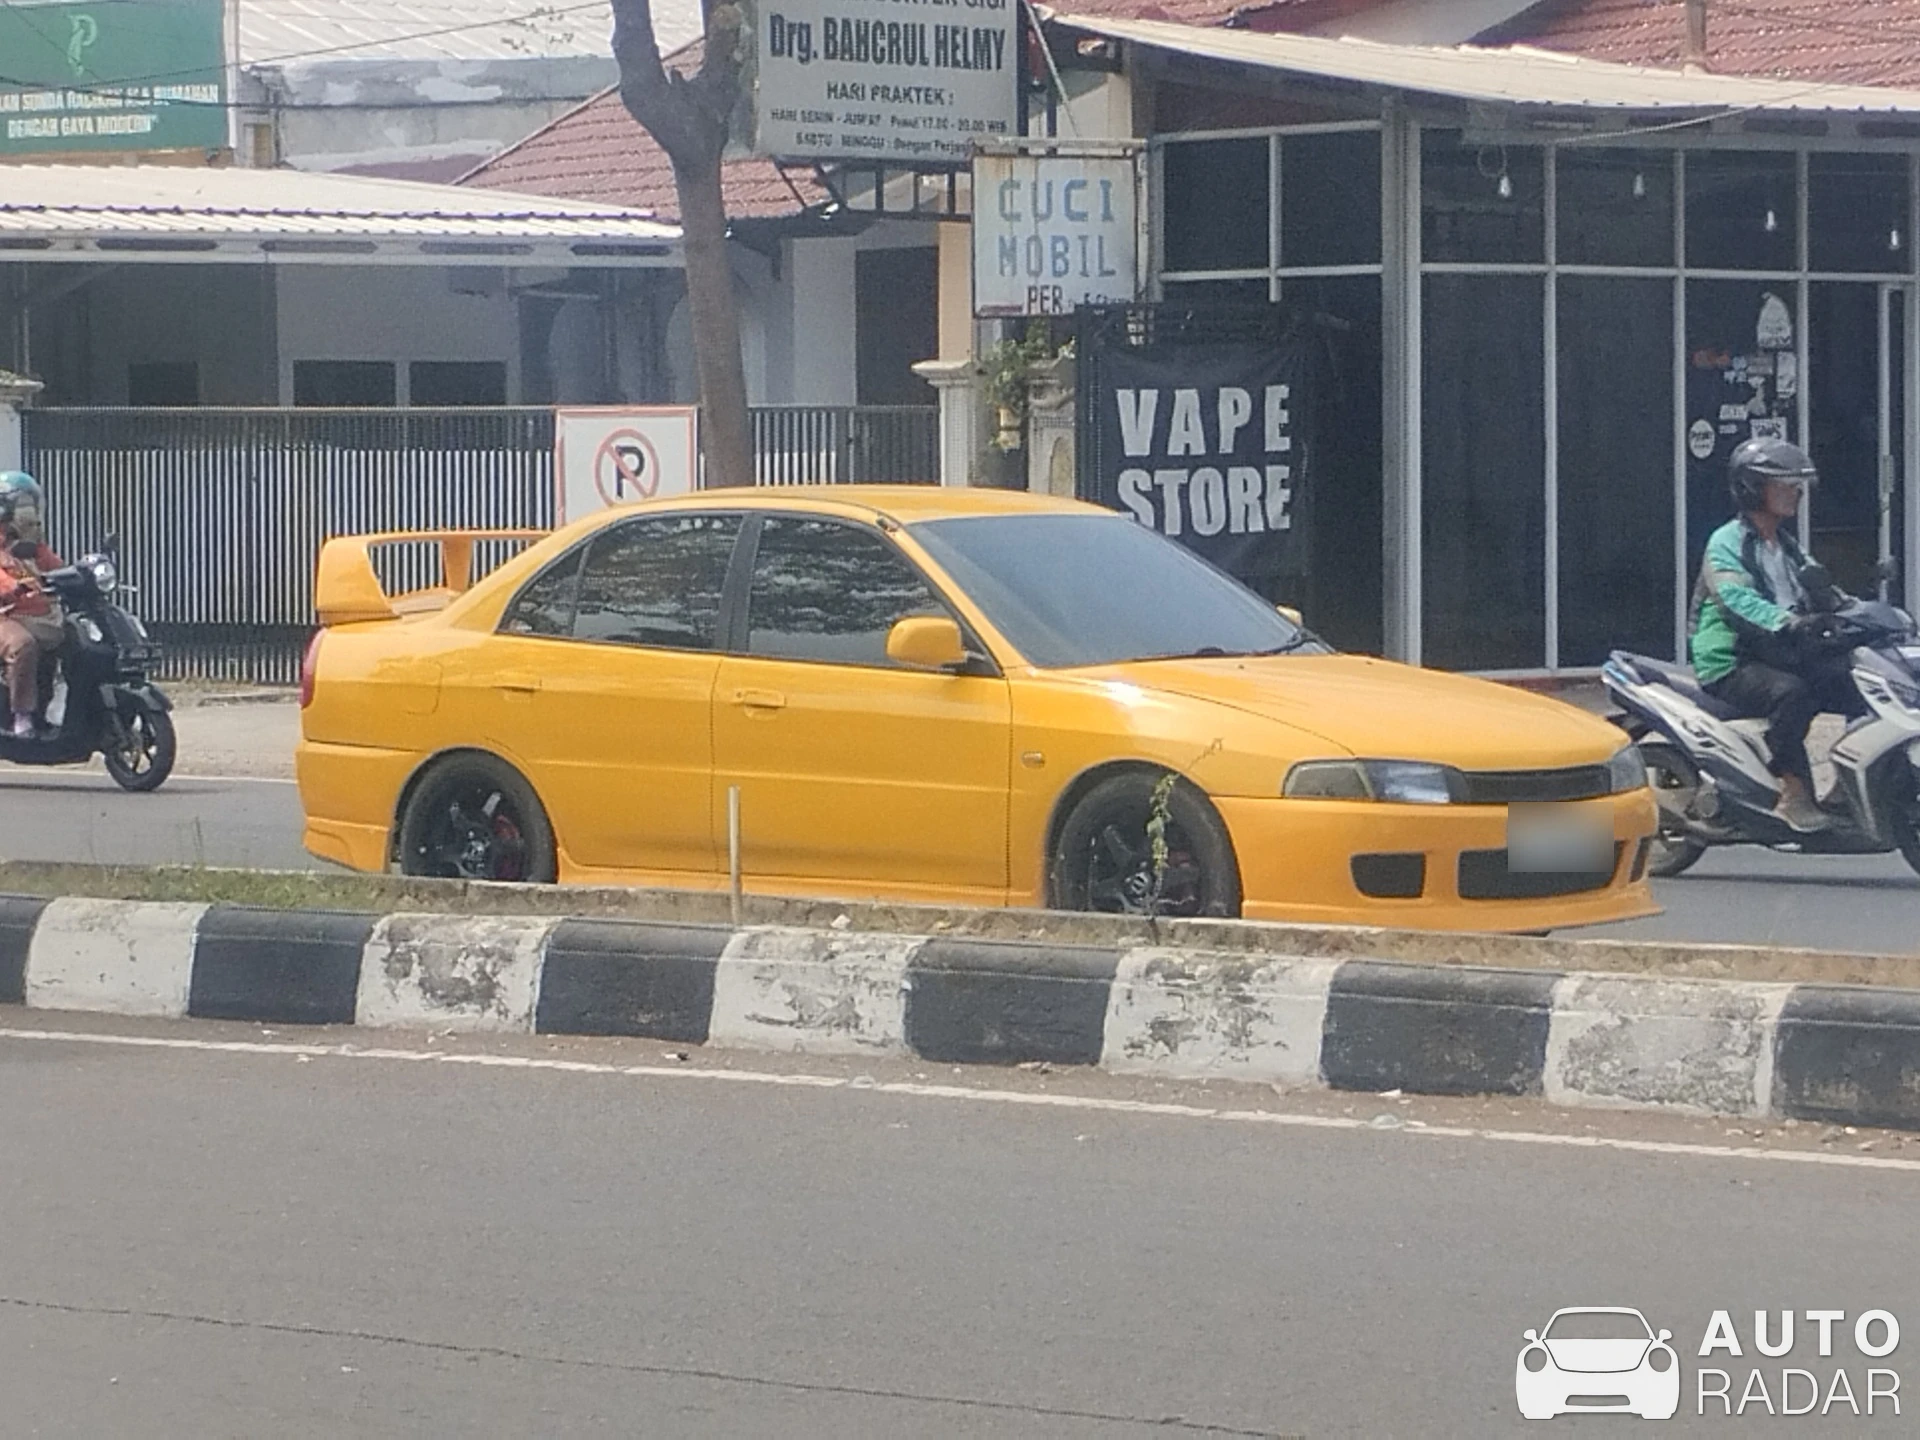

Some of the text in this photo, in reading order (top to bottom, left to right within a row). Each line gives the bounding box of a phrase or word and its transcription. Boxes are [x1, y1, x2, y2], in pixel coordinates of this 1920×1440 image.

[769, 12, 818, 65] Drg.
[934, 24, 1006, 71] HELMY
[770, 108, 797, 121] HARI
[826, 81, 866, 101] HARI
[870, 84, 945, 105] PRAKTEK
[60, 115, 94, 137] GAYA
[998, 178, 1115, 222] CUCI
[998, 234, 1117, 278] MOBIL
[1116, 384, 1291, 457] VAPE
[1117, 465, 1291, 536] STORE
